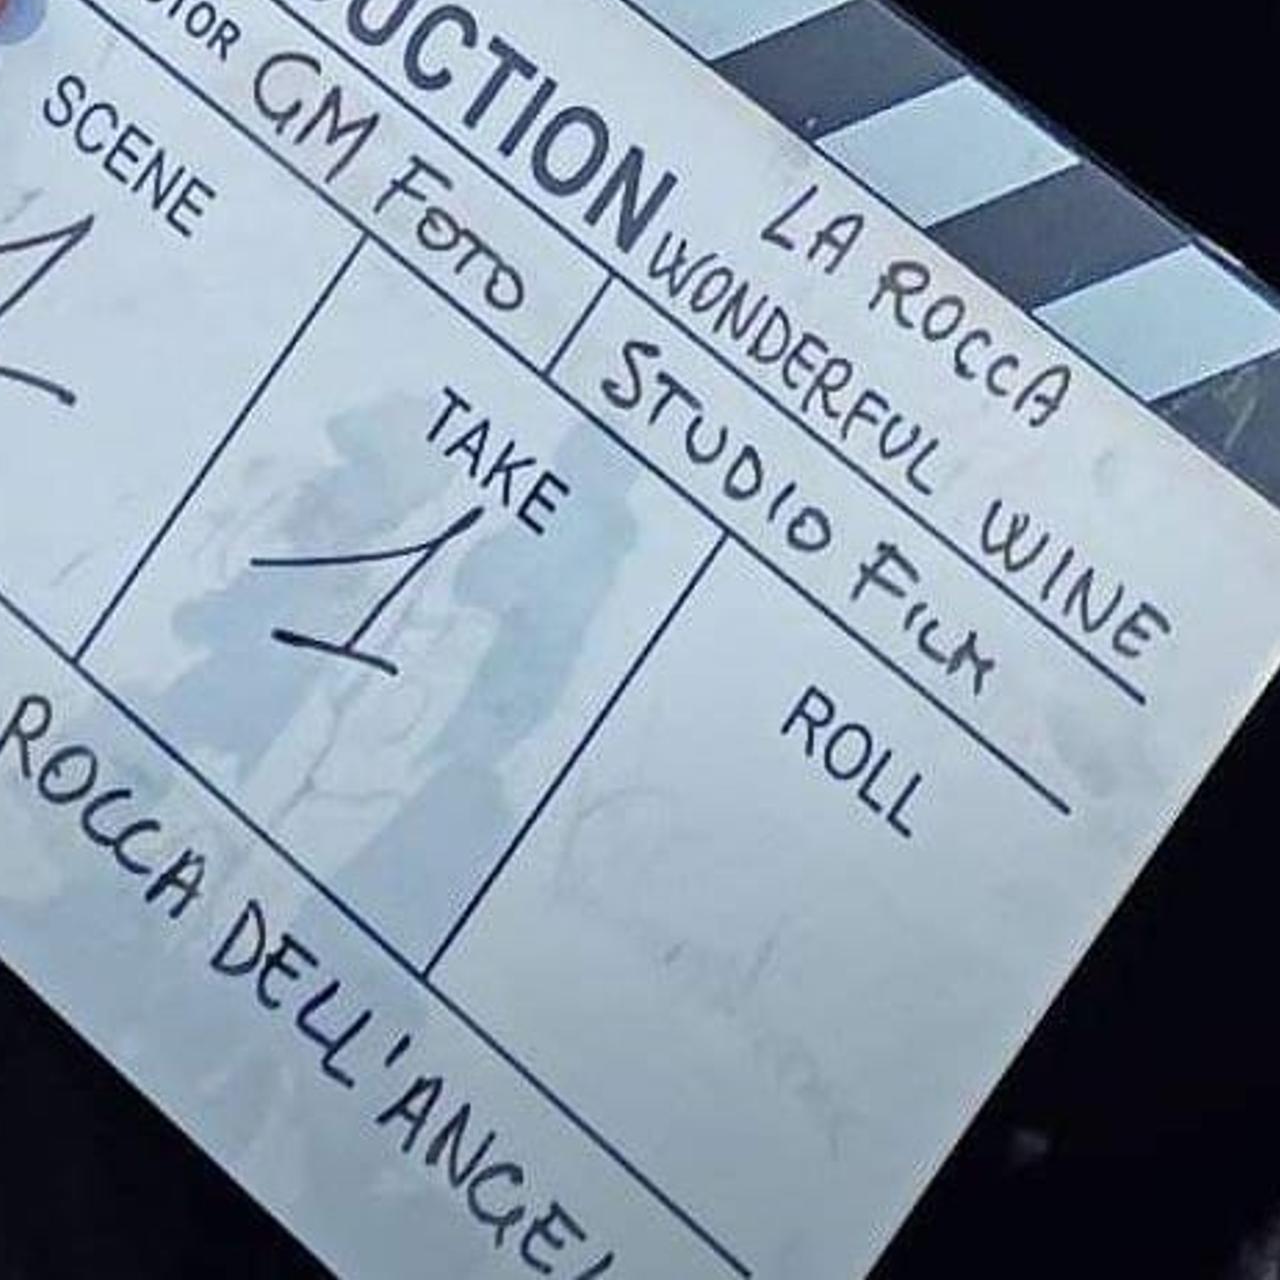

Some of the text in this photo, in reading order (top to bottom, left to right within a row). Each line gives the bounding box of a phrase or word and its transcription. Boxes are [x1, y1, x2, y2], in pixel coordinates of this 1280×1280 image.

[42, 74, 217, 239] SCENE
[253, 51, 381, 184] GM
[601, 338, 832, 554] STUDIO
[760, 184, 1072, 429] LA ROCCA
[425, 387, 570, 536] TAKE
[646, 230, 1172, 660] WONDERFUL WINE
[251, 506, 485, 677] 1
[780, 685, 923, 838] ROLL
